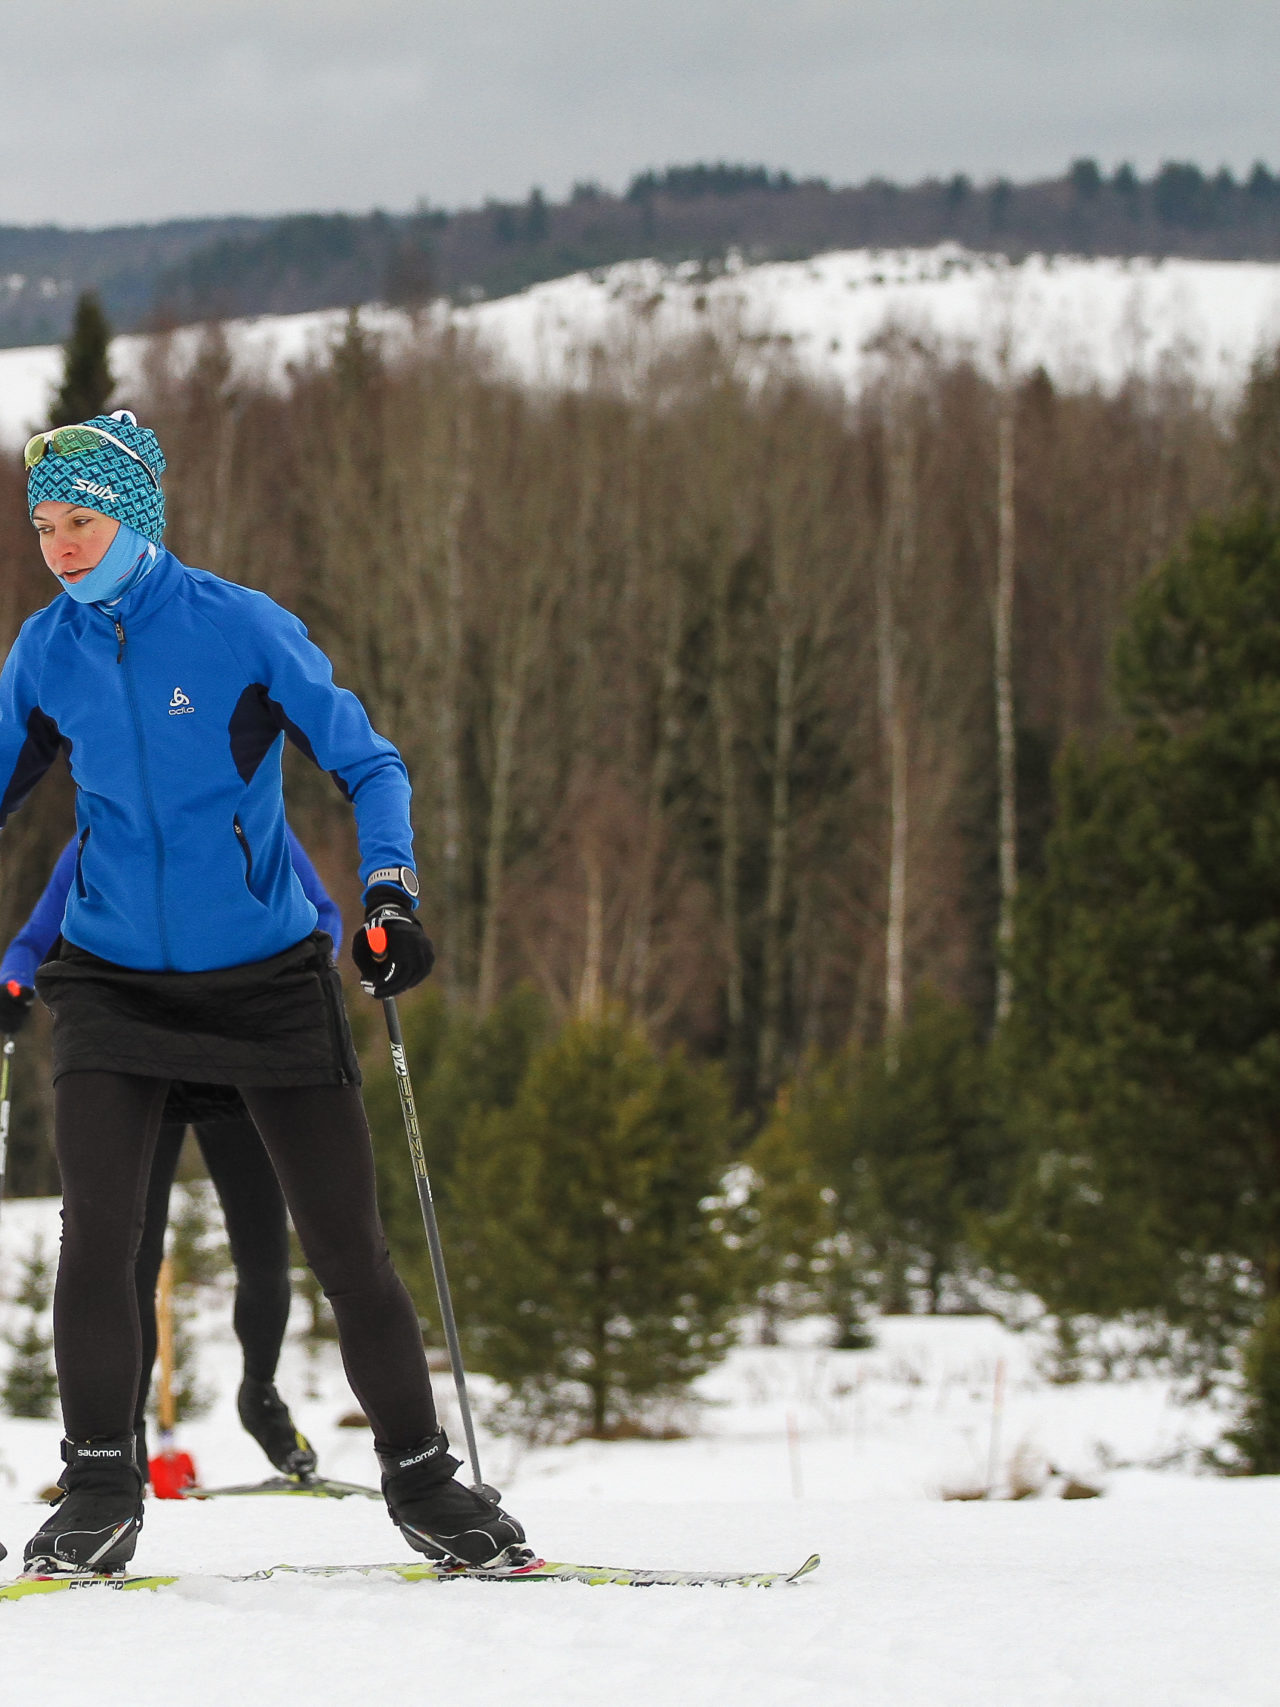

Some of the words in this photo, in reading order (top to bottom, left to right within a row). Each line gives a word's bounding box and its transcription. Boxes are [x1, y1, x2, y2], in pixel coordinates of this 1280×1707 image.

[168, 706, 195, 716] odlo
[76, 1449, 122, 1458] salomon
[399, 1445, 440, 1469] salomon
